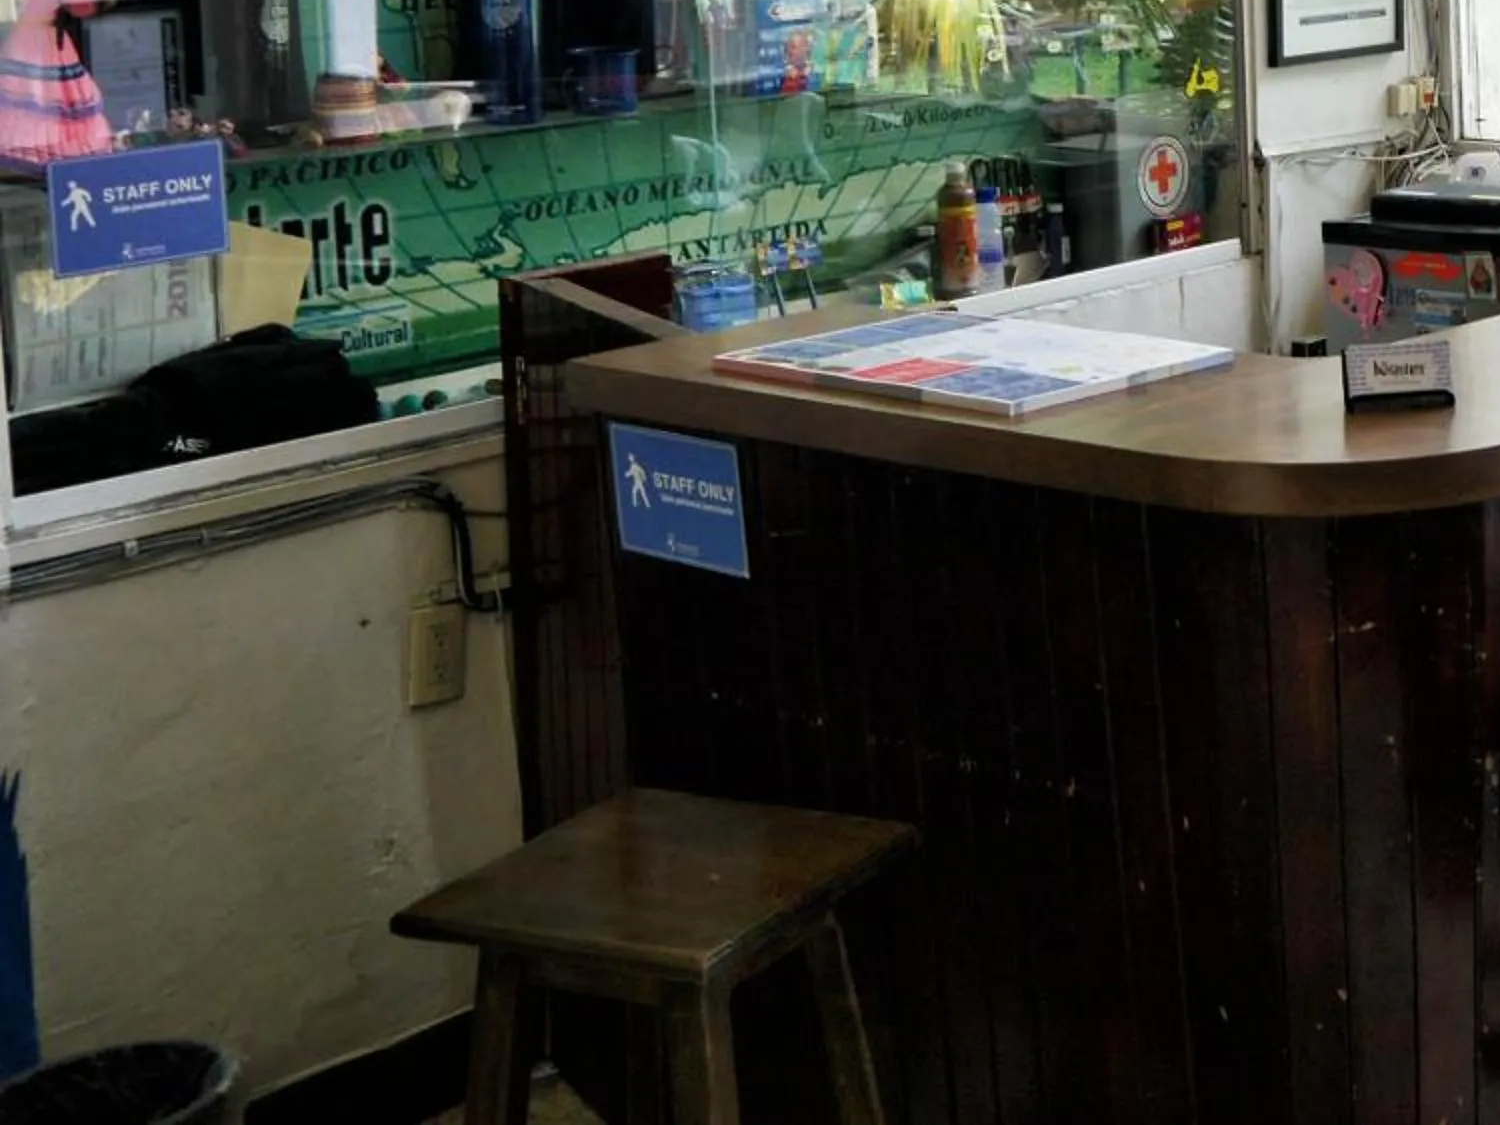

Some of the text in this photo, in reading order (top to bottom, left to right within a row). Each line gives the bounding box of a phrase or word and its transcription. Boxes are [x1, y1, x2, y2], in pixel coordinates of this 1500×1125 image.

[102, 180, 161, 204] STAFF
[164, 173, 213, 195] ONLY
[341, 321, 409, 353] Cultural
[653, 472, 735, 503] STAFF ONLY
